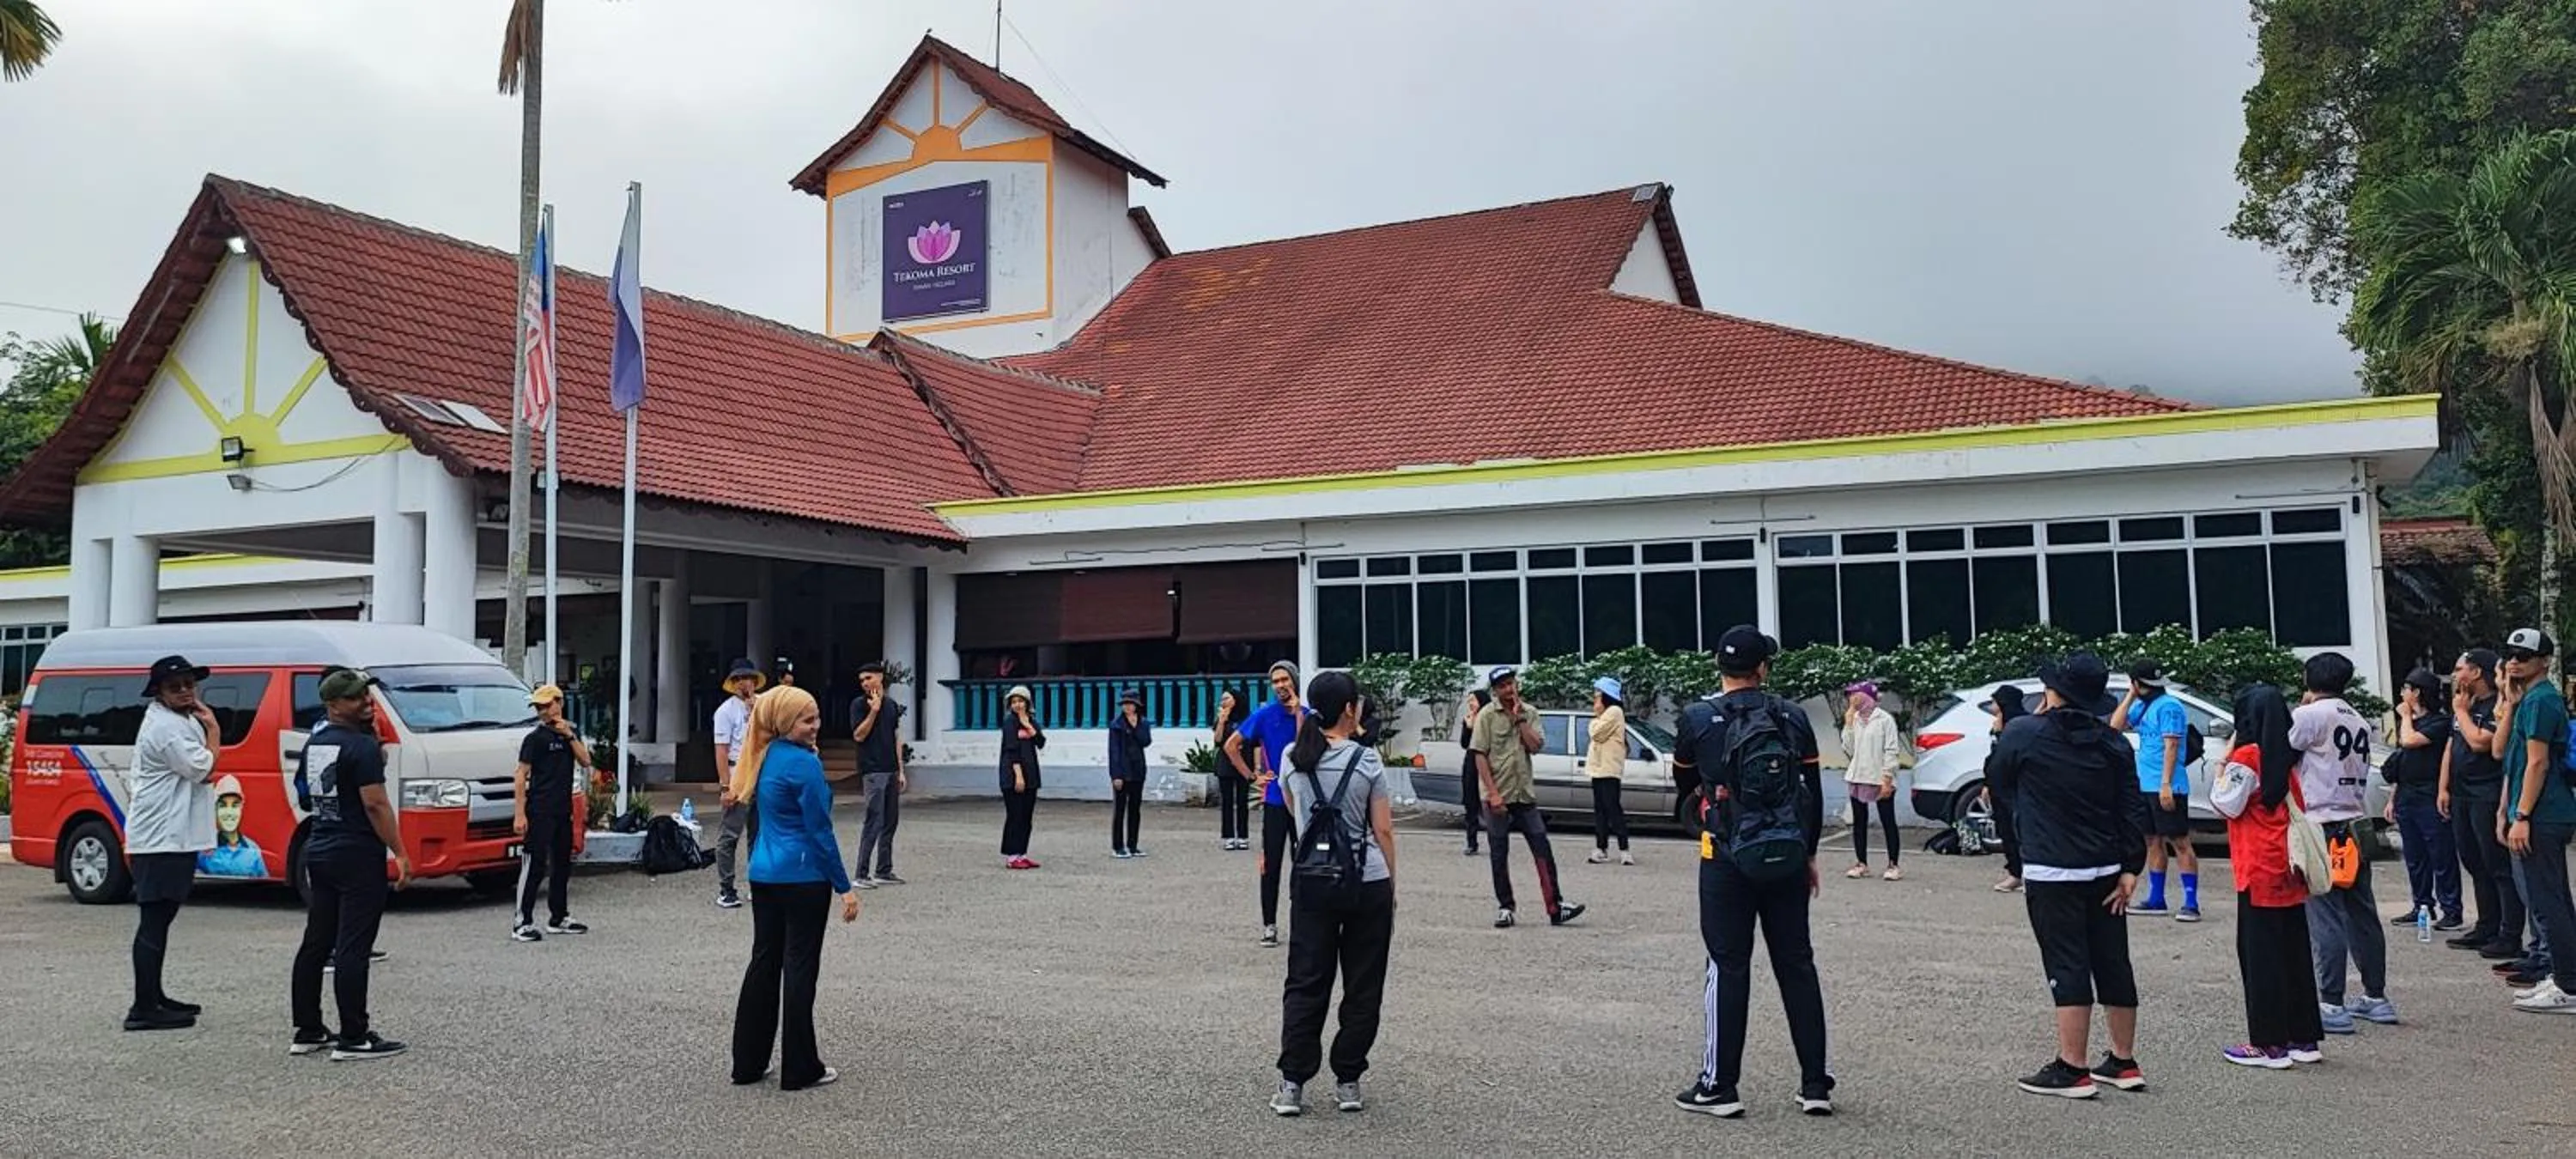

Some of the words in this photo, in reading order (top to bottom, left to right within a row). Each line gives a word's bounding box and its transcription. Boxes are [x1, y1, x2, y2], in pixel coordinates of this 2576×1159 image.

[893, 269, 934, 282] TEKOMA
[937, 262, 976, 276] RESORT
[2333, 725, 2370, 762] 94
[26, 761, 62, 776] 15454
